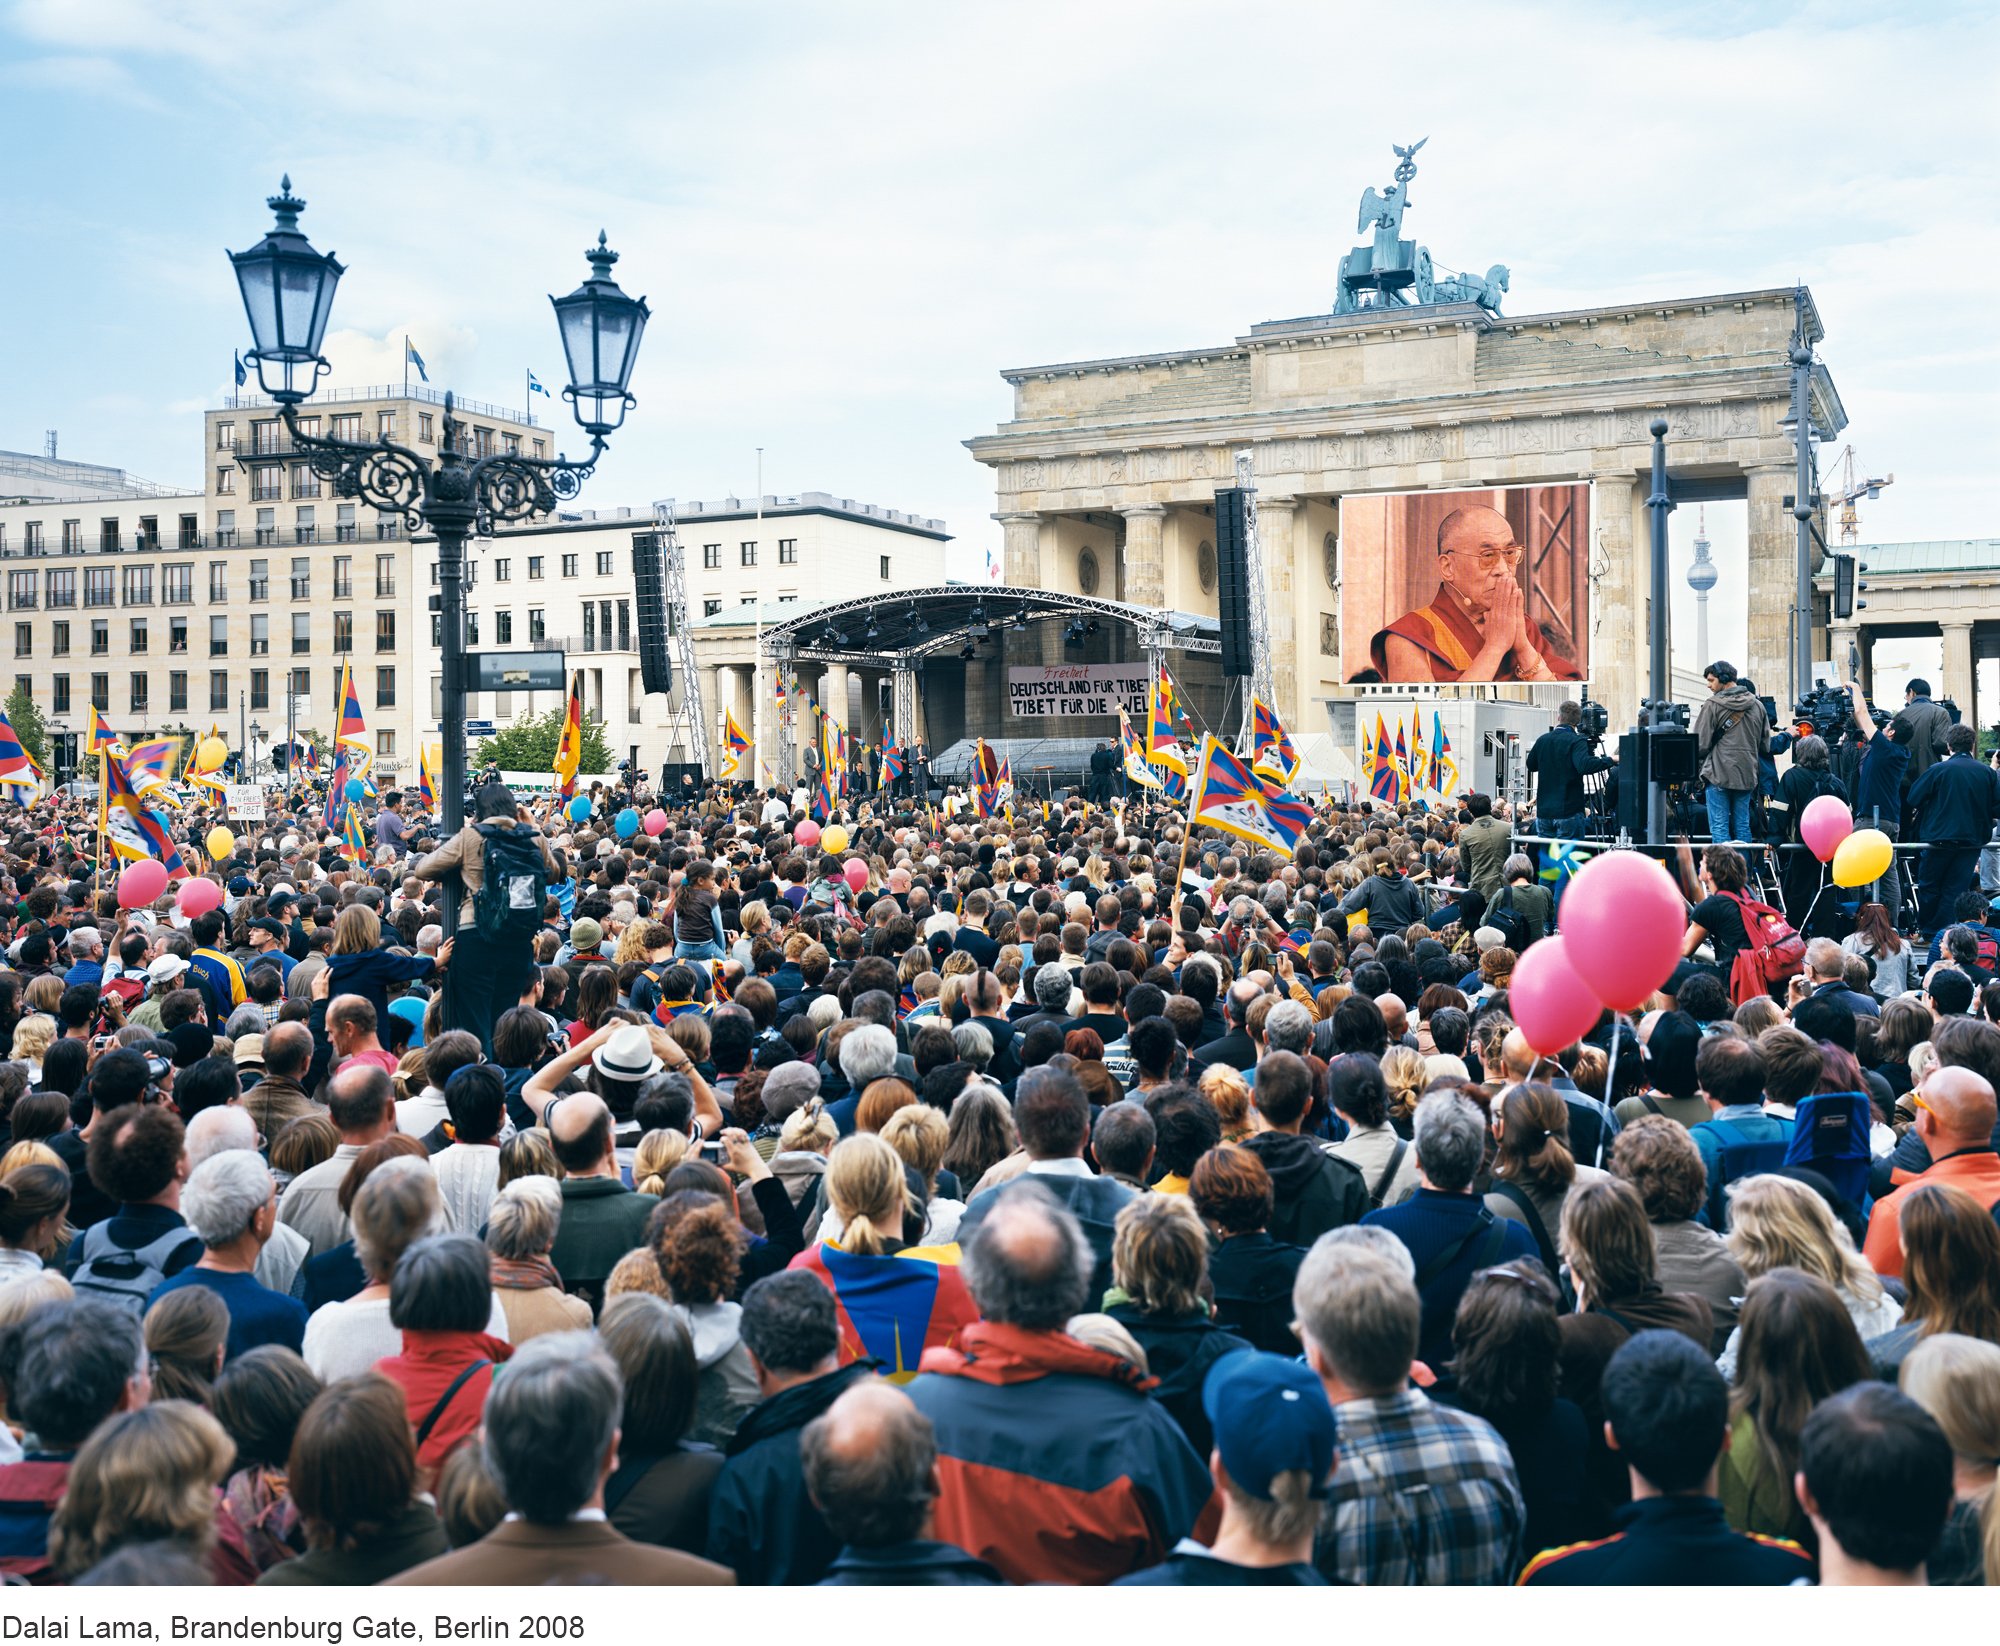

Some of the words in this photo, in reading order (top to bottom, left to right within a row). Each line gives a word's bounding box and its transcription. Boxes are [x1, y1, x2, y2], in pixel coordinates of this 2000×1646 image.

[1044, 665, 1090, 679] Freiheit
[1010, 680, 1091, 697] DEUTSCHLAND
[1093, 679, 1115, 694] FÜR
[1012, 697, 1056, 715] TIBET
[1060, 697, 1084, 714] FÜR
[1088, 697, 1108, 714] DIE
[1116, 695, 1149, 713] WEL
[237, 787, 250, 796] FÜR
[237, 805, 261, 815] TIBET
